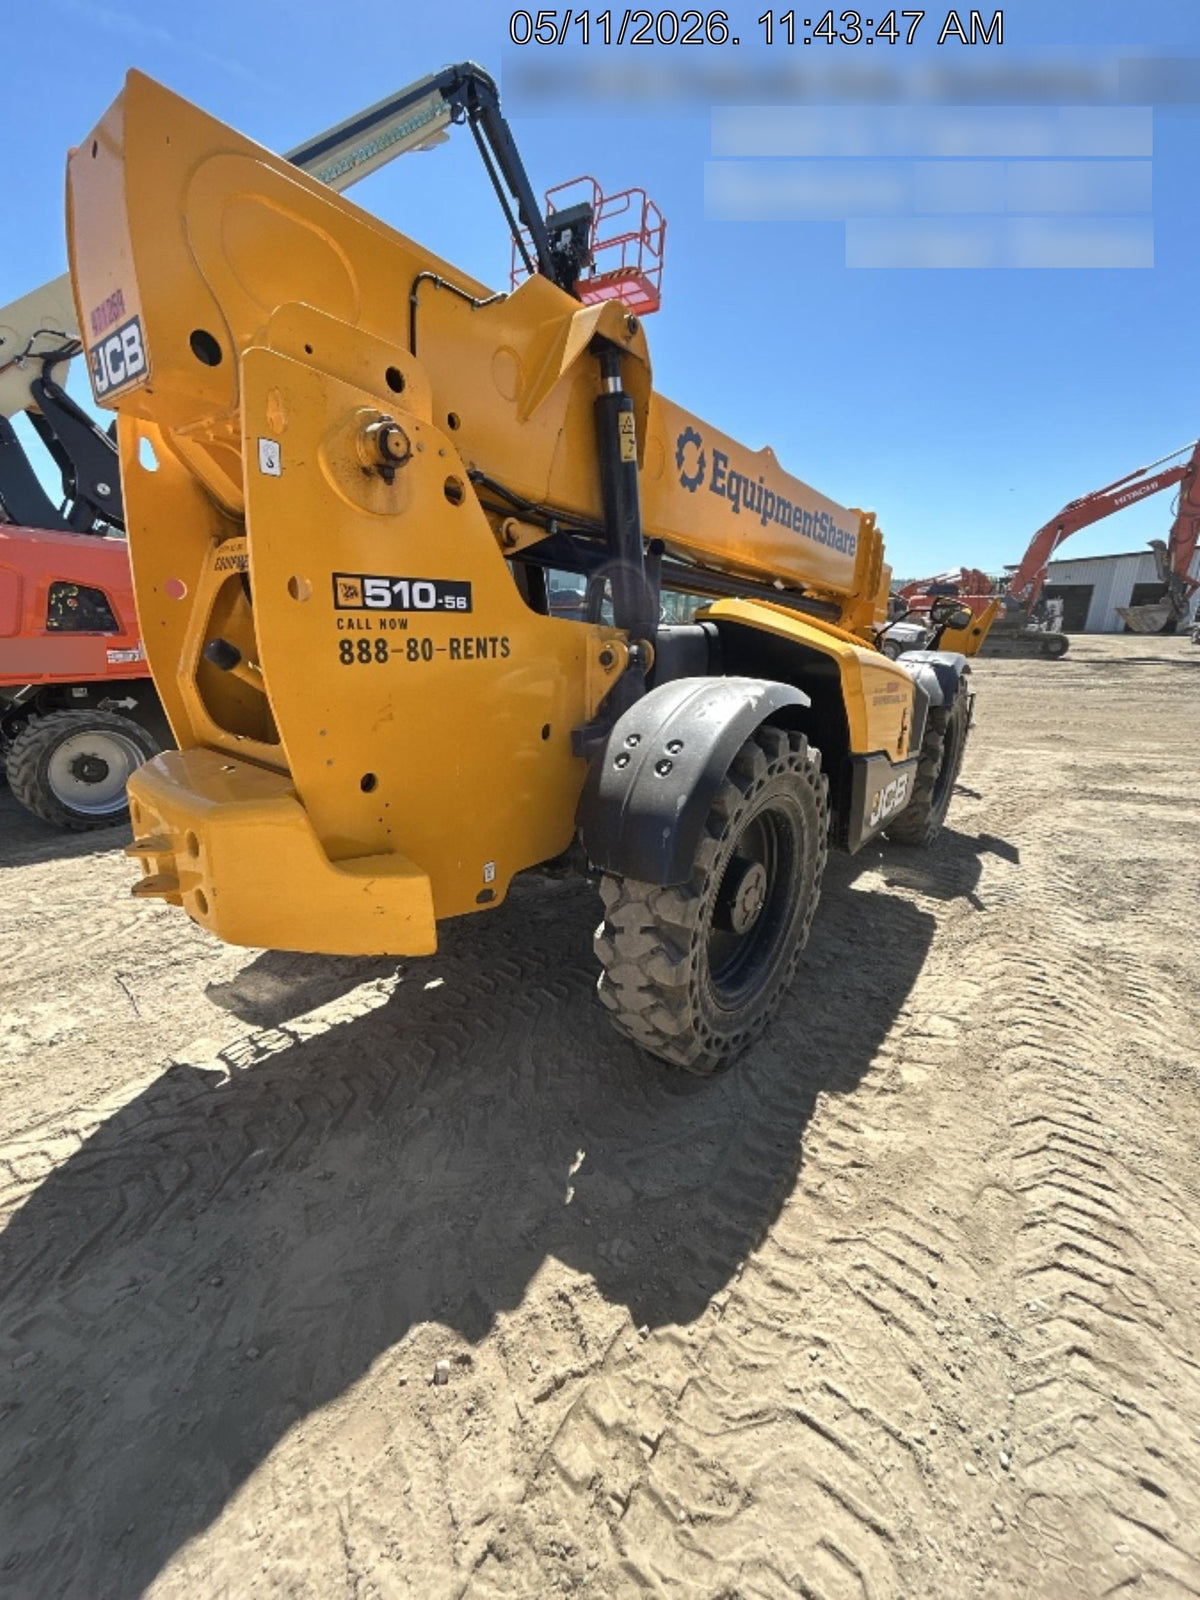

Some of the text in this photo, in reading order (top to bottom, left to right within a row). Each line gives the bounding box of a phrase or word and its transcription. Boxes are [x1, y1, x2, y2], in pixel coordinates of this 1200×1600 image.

[95, 323, 145, 393] JCB
[709, 448, 857, 557] EquipmentShare
[337, 618, 408, 630] CALL NOW
[338, 636, 511, 666] 888-80-RENTS
[869, 773, 910, 827] JCB
